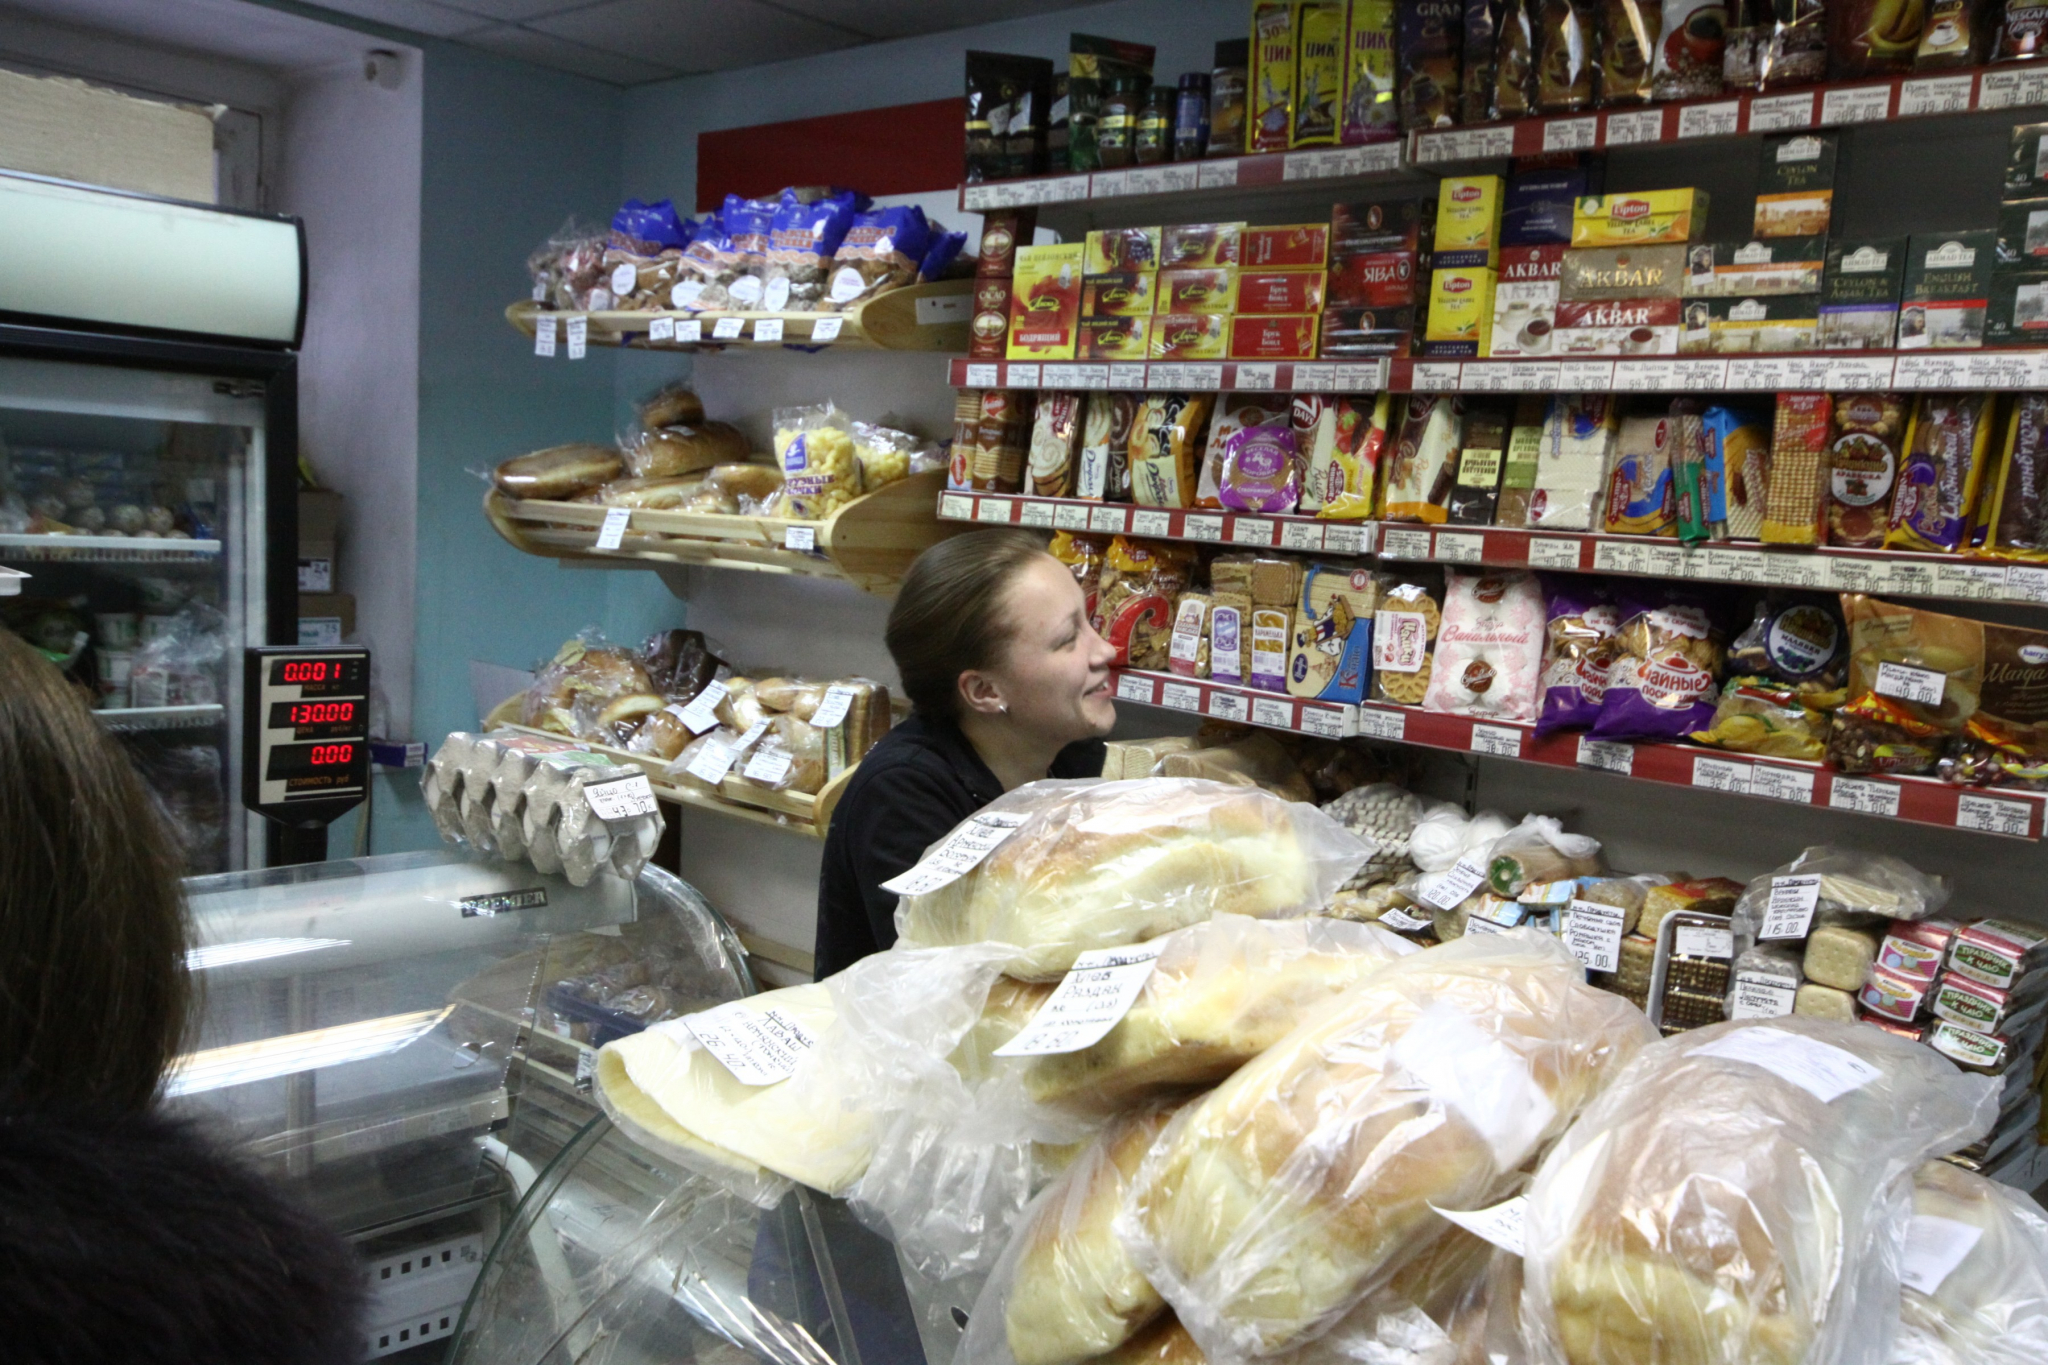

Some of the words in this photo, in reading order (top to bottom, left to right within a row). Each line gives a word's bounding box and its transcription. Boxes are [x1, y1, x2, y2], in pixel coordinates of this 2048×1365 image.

[1453, 188, 1481, 199] Lipton
[1613, 204, 1648, 217] Lipton
[1363, 266, 1396, 283] ЯВА
[1504, 262, 1561, 279] AKBAR
[1578, 268, 1664, 289] AKBAR
[1444, 280, 1472, 291] Lipton
[1580, 309, 1650, 327] AKBAR
[1292, 391, 1318, 418] 7
[1294, 407, 1314, 426] DAYS
[1441, 624, 1531, 645] Ванильный
[288, 776, 333, 788] СТОИМОСТЬ
[1960, 946, 2009, 969] ПРАЗДНИК
[1976, 959, 2000, 974] ЧАЮ
[1945, 991, 1993, 1015] ПРАЗДНИК
[1960, 1005, 1984, 1019] ЧАЮ
[1947, 1027, 1995, 1050] ПРАЗДНИК
[1961, 1039, 1985, 1054] ЧАЮ
